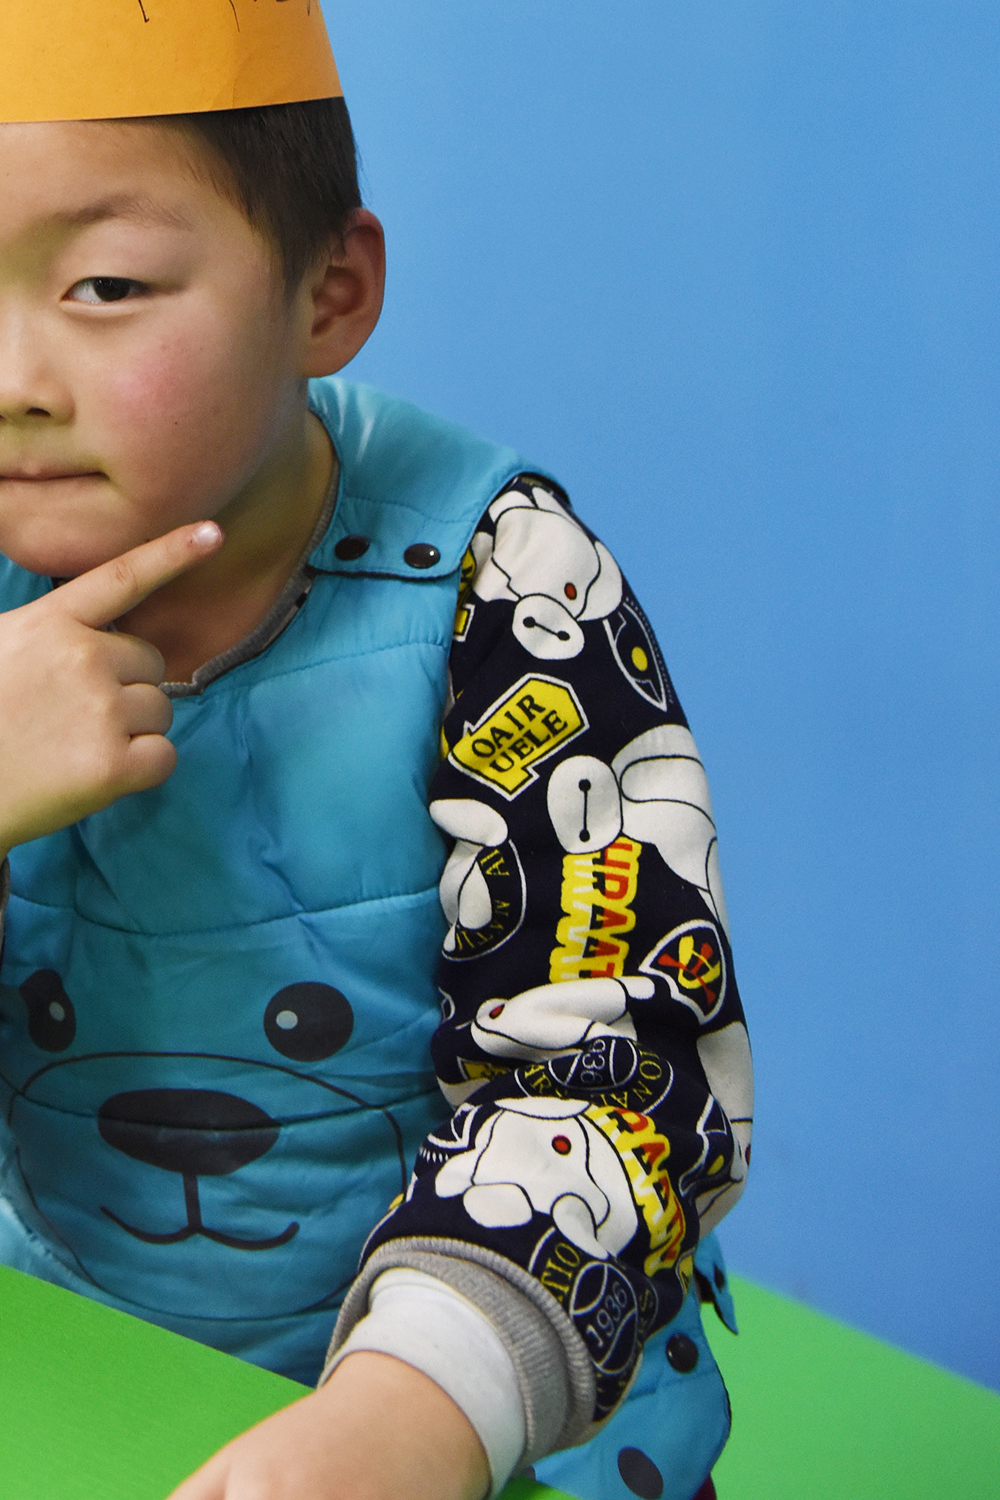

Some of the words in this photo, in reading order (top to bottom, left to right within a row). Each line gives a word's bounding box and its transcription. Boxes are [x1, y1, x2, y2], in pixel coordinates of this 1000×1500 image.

[471, 693, 545, 761] OAIR
[488, 708, 569, 776] UELE
[541, 1241, 582, 1299] TIO
[585, 1281, 628, 1348] 1936
